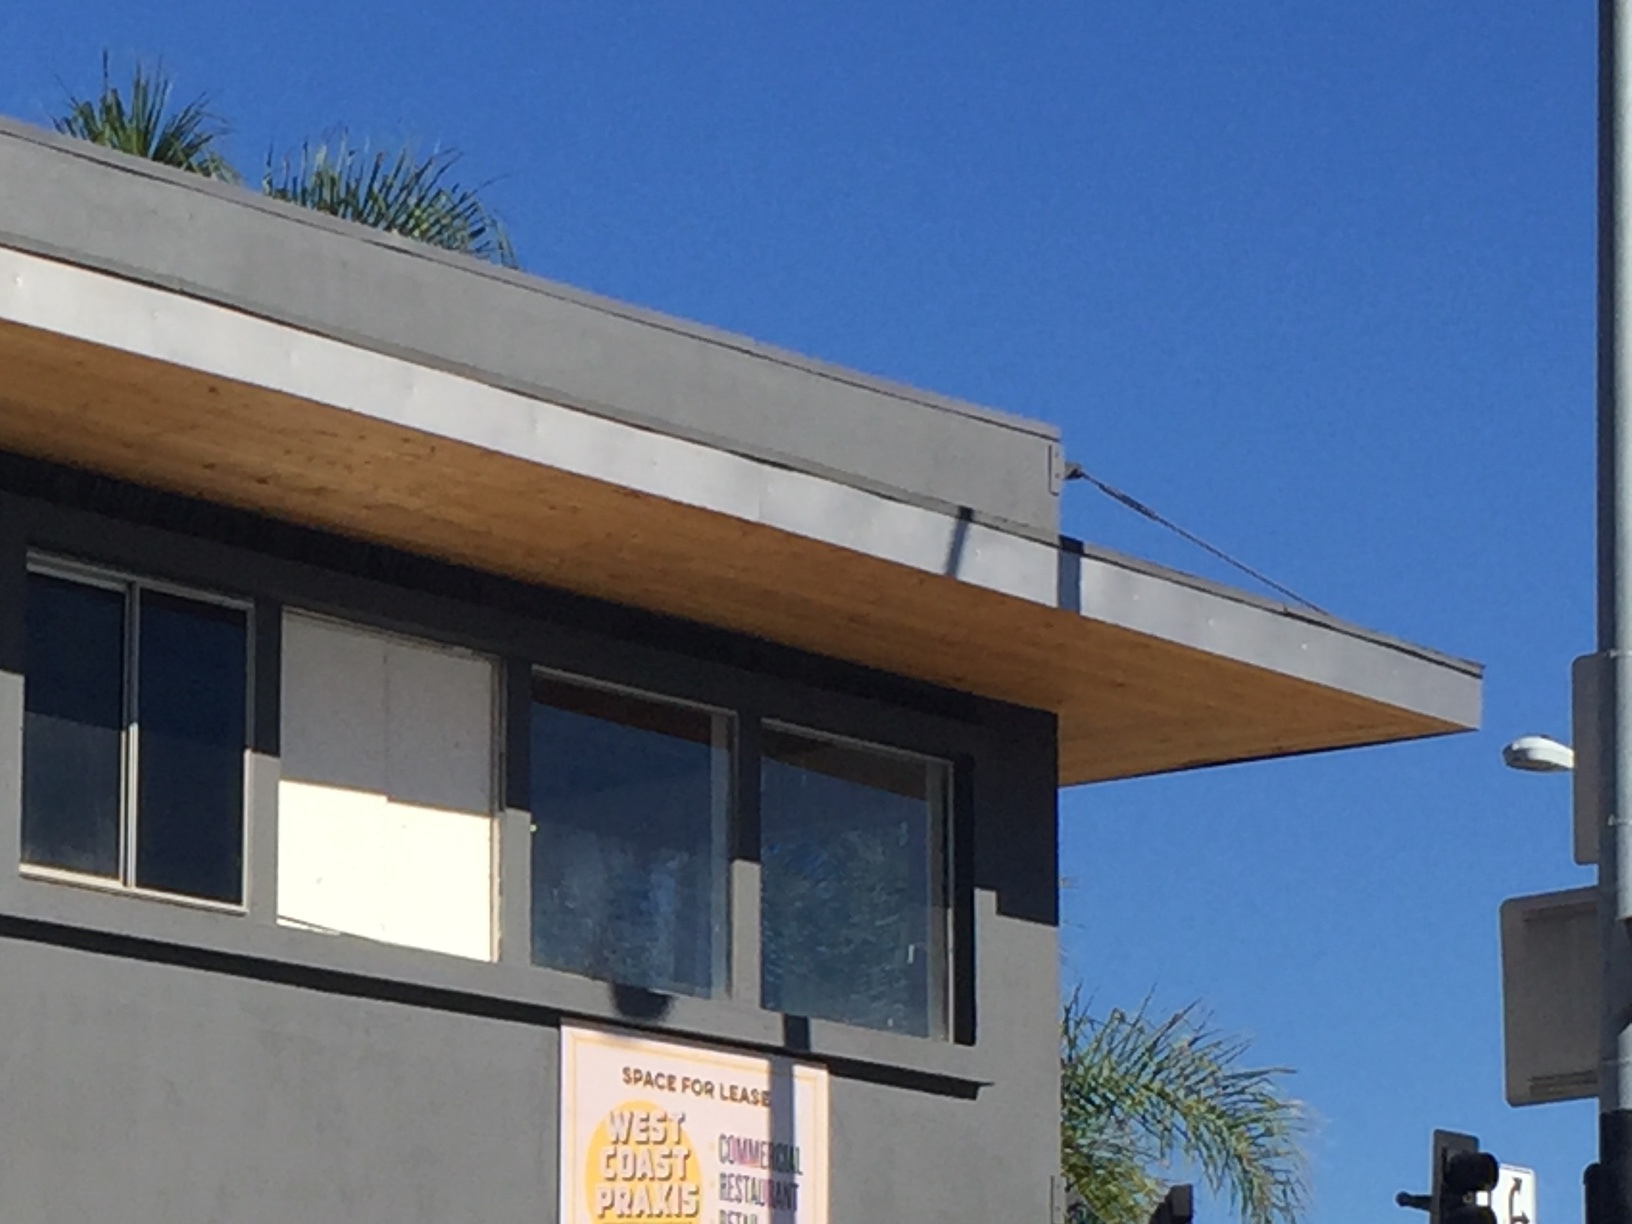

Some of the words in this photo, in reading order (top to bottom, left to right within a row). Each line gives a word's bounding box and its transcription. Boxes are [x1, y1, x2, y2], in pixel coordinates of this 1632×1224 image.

[621, 1066, 678, 1092] SPACE
[680, 1076, 716, 1099] FOR
[719, 1081, 772, 1107] LEASE
[607, 1109, 687, 1145] WEST
[599, 1146, 691, 1182] COAST
[718, 1133, 804, 1176] COMMERCIAL
[596, 1185, 701, 1219] PRAXIS
[718, 1172, 800, 1214] RESTAURANT
